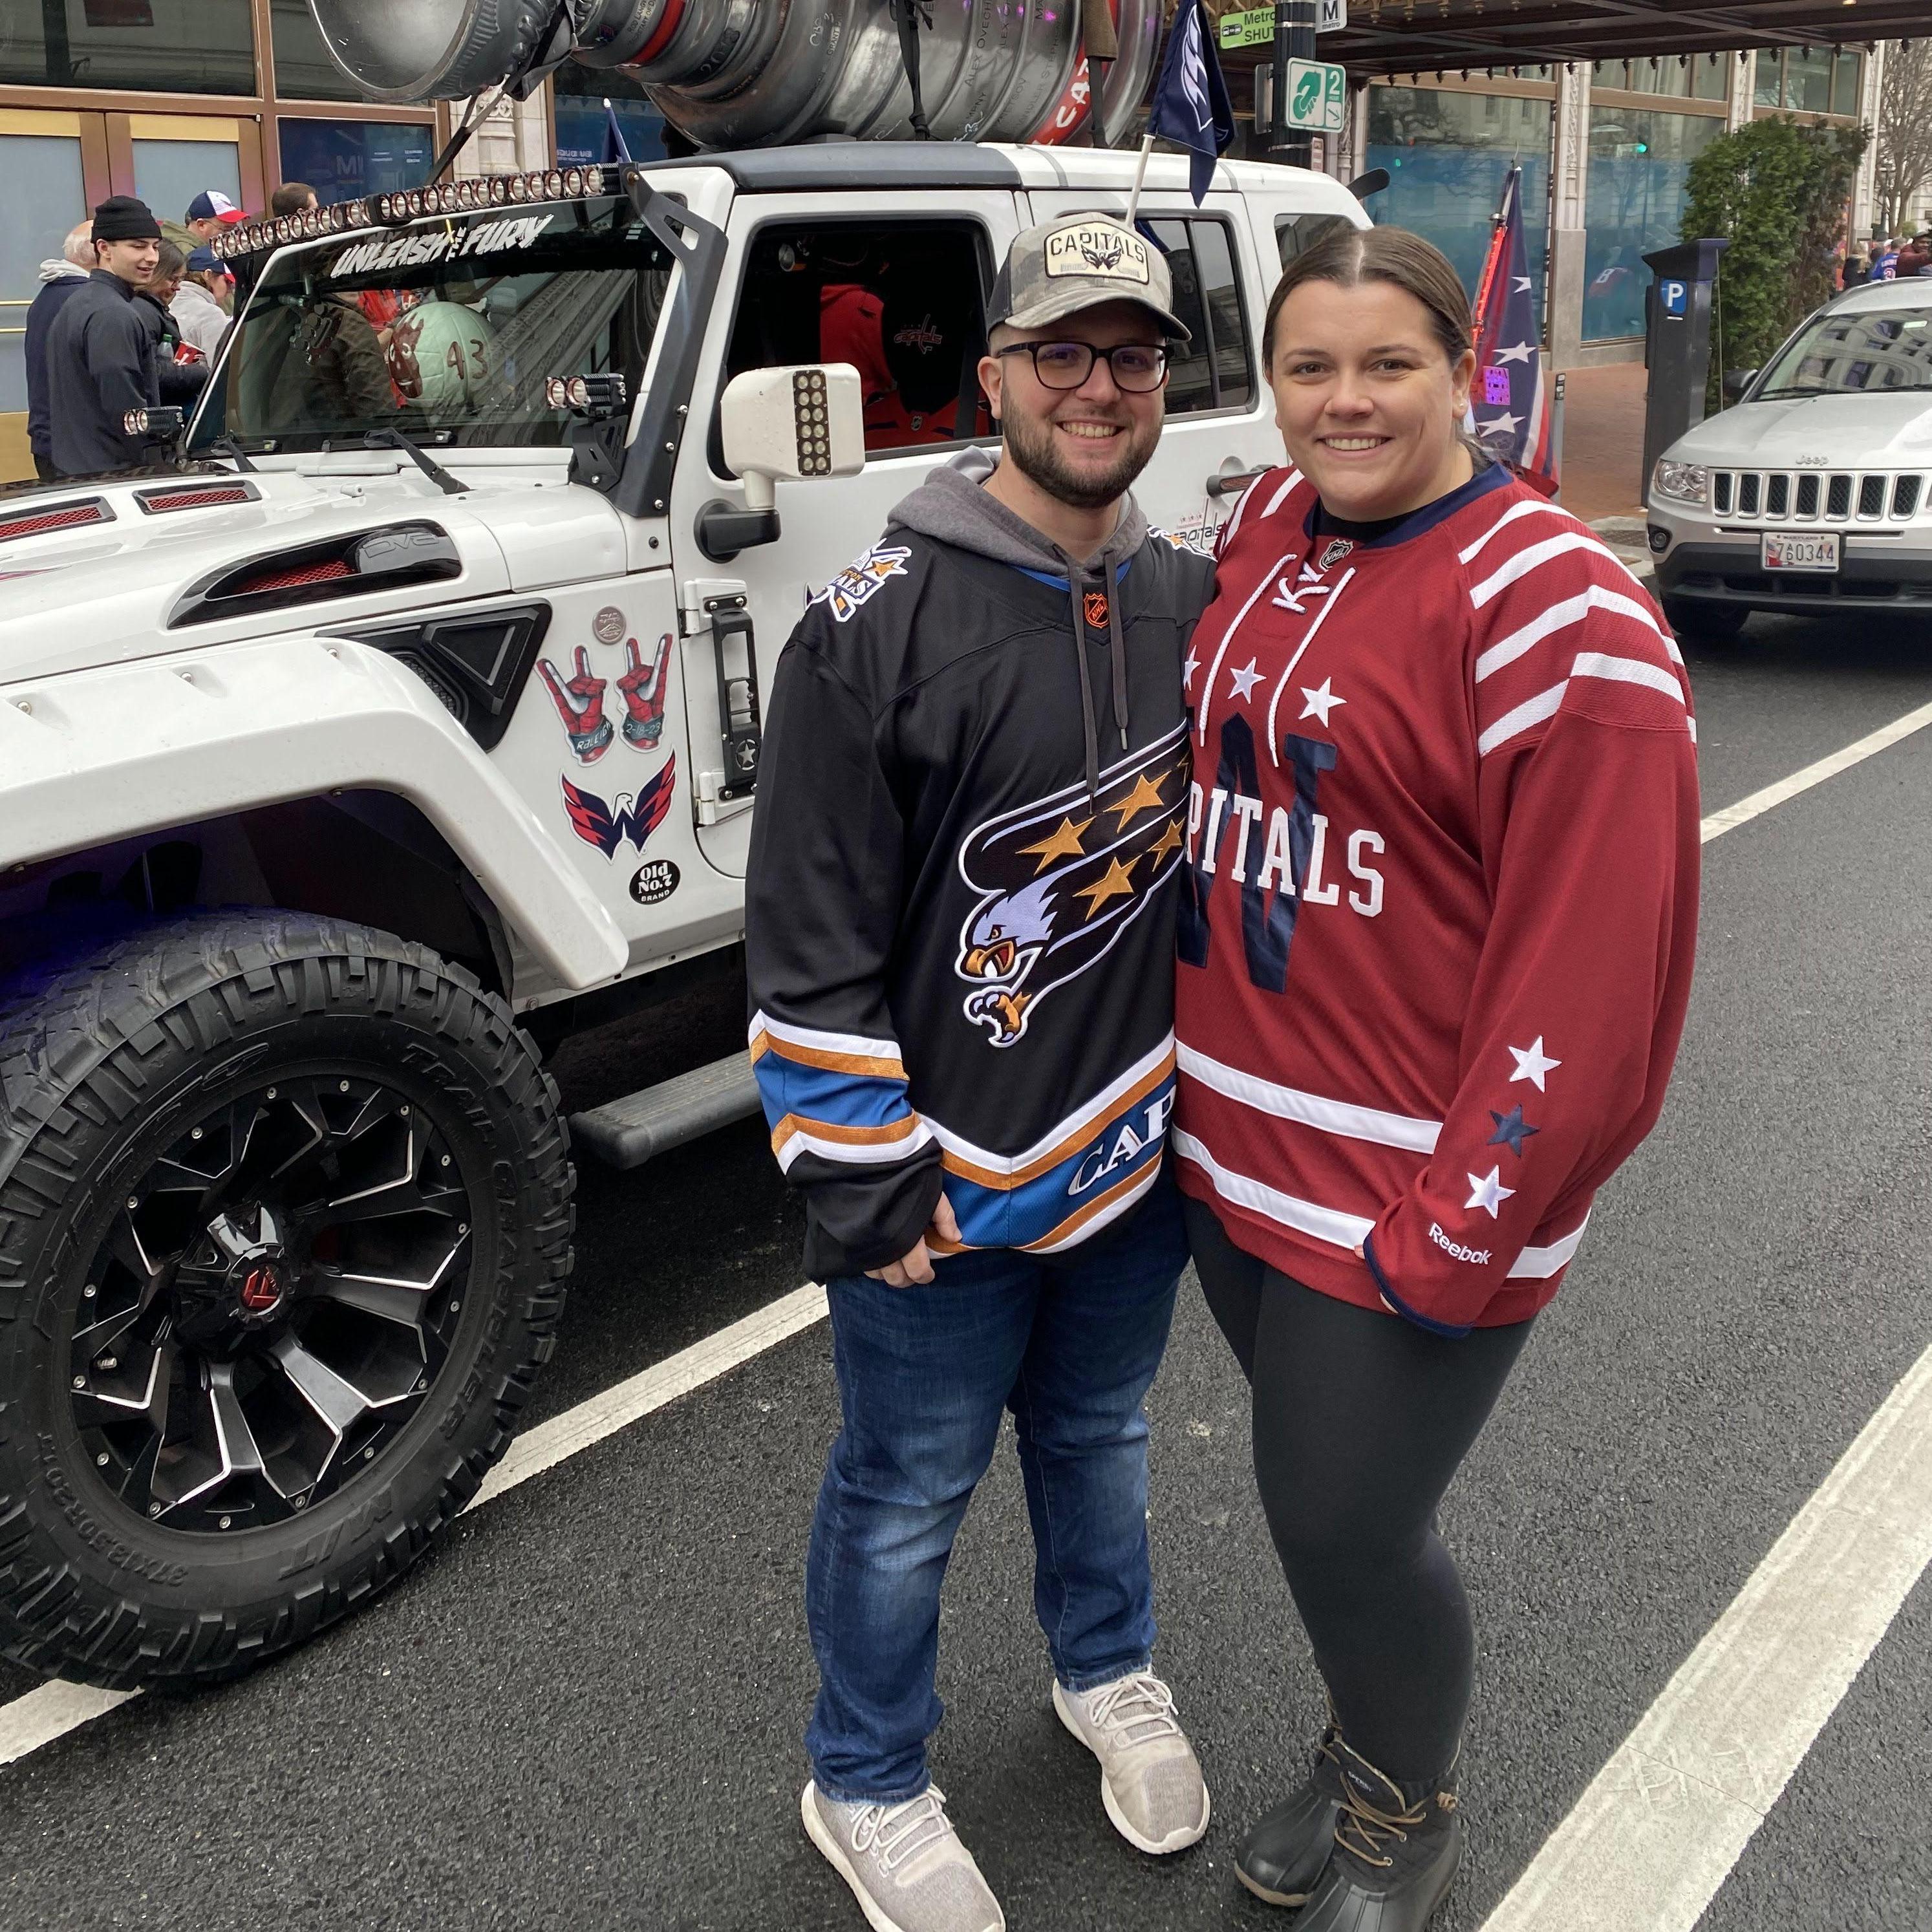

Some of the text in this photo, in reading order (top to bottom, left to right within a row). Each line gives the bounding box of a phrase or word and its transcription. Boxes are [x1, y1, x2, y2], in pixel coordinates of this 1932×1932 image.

[965, 0, 993, 87] ALEX OVECH
[1329, 70, 1340, 95] 2
[330, 231, 456, 279] UNLEASH
[459, 213, 554, 257] FURY
[1051, 232, 1144, 264] CAPITALS
[1667, 283, 1684, 308] P
[1795, 455, 1830, 466] Jeep
[625, 722, 662, 736] 2-18-23
[639, 861, 669, 881] Old
[638, 874, 672, 894] No.7
[641, 889, 671, 902] BRAND
[1428, 1222, 1493, 1265] Reebok
